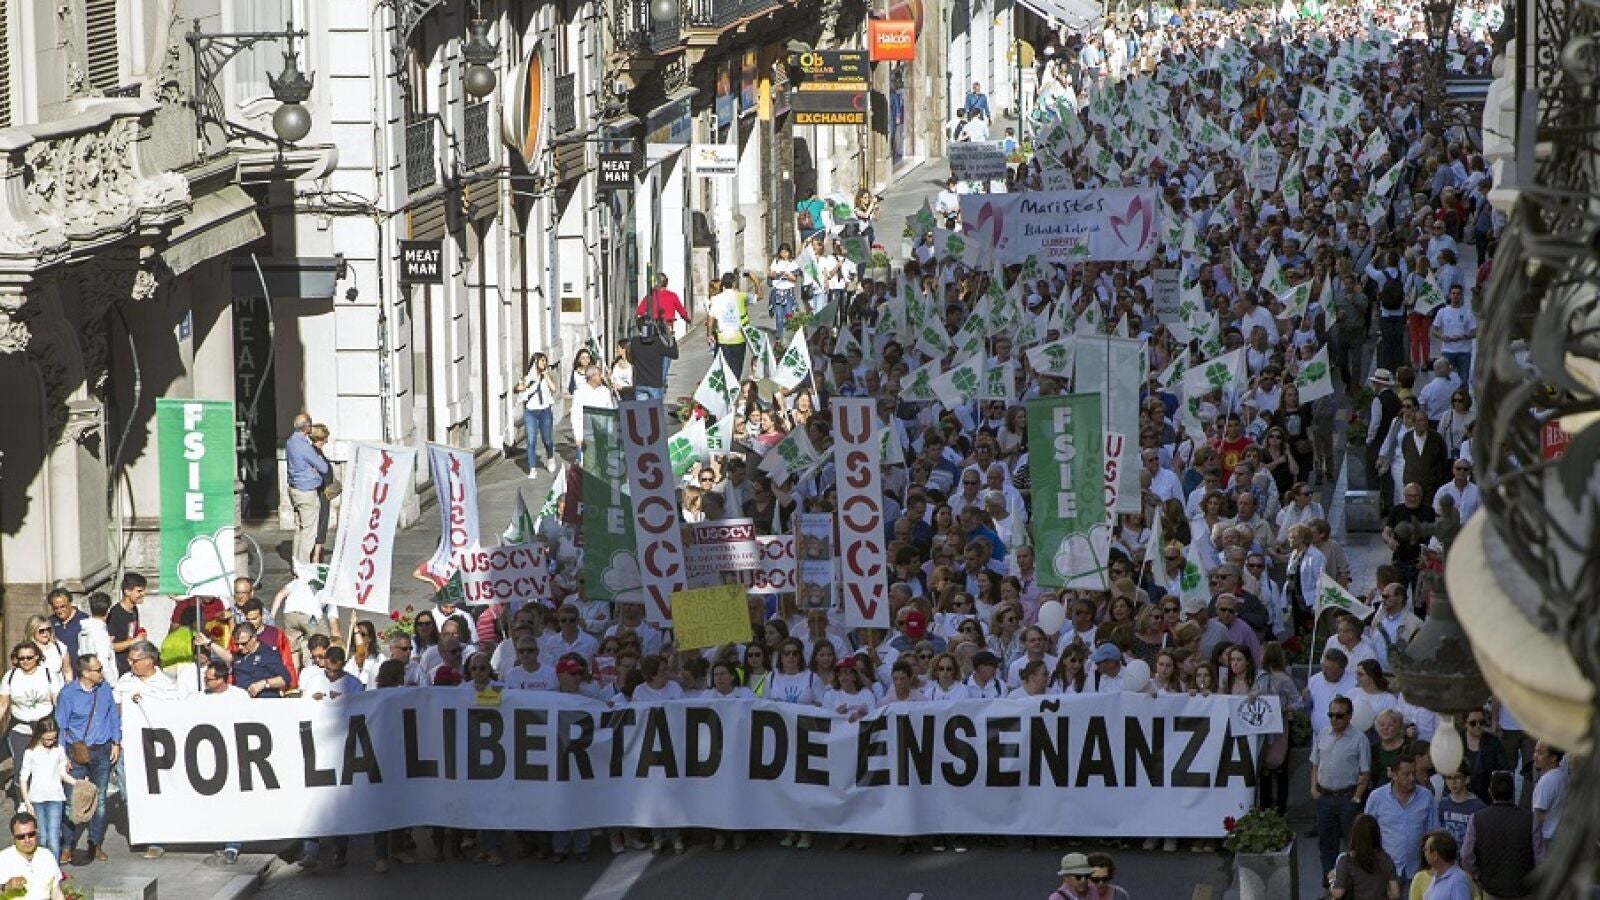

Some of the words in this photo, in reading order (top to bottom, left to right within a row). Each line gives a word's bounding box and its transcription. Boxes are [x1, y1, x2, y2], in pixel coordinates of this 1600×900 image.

[796, 112, 864, 123] EXCHANGE
[602, 160, 631, 171] MEAT
[605, 171, 628, 182] MAN
[405, 249, 440, 261] MEAT
[408, 263, 437, 275] MAN
[182, 403, 206, 521] FSIE
[1053, 406, 1078, 518] FSIE
[838, 405, 884, 620] USOCV
[355, 481, 390, 605] USOCV
[699, 525, 752, 540] USOCV
[460, 547, 544, 572] USOCV
[463, 576, 547, 602] USOCV
[141, 722, 280, 797] POR
[300, 714, 383, 788] LA
[403, 707, 722, 782] LIBERTAD
[749, 709, 830, 786] DE
[855, 699, 1257, 788] ENSEÑANZA
